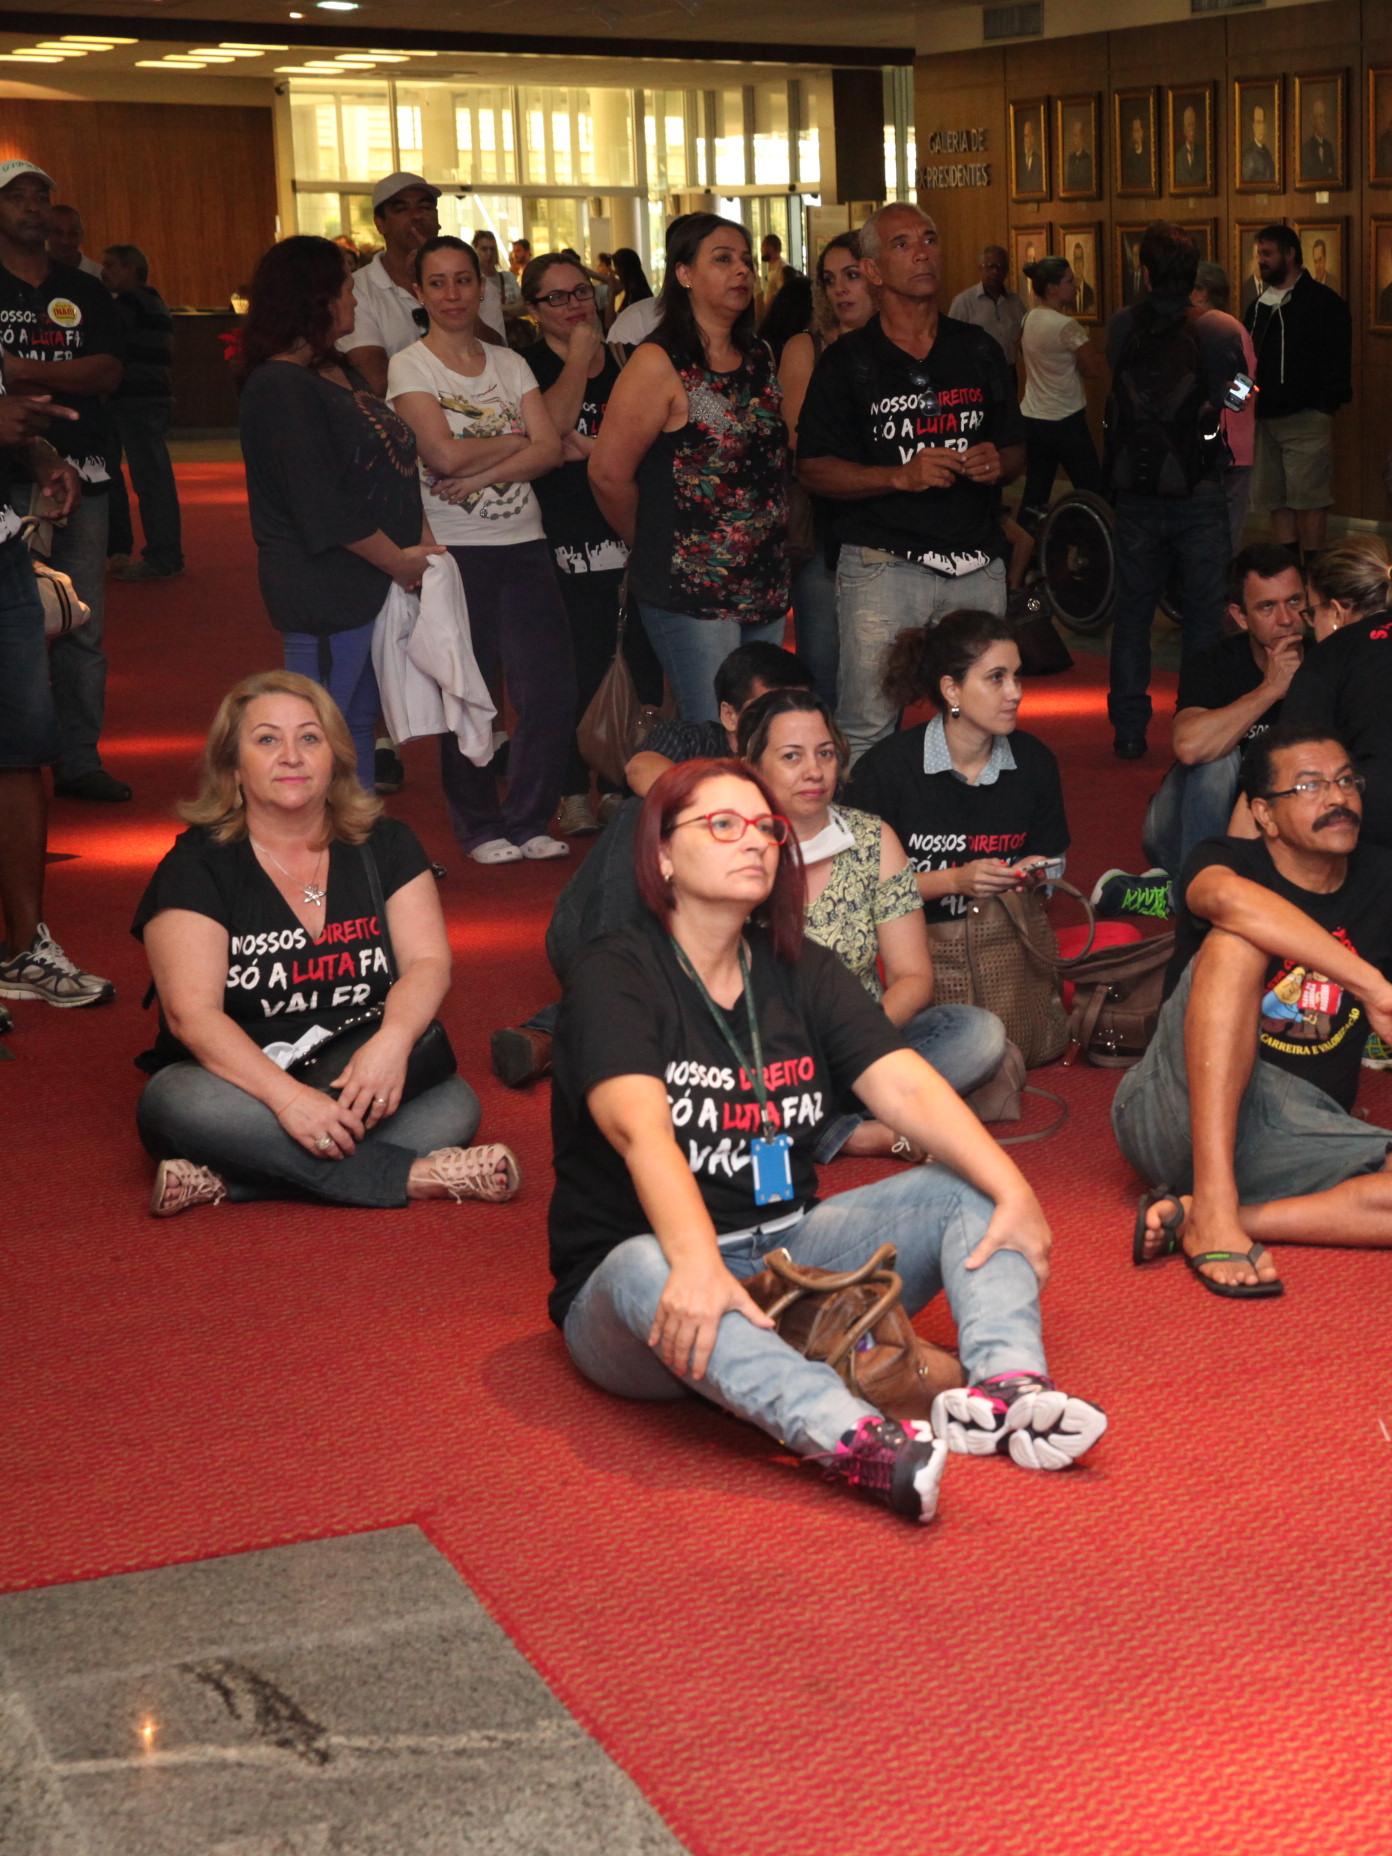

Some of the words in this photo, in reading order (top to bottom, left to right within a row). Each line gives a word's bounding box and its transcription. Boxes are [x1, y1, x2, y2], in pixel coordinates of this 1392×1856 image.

[929, 131, 969, 154] GALERIA
[971, 128, 985, 151] DE
[916, 163, 989, 188] X-PRESIDENTES
[0, 310, 37, 323] OSSOS
[19, 328, 28, 346] A
[870, 393, 926, 416] NOSSOS
[901, 418, 914, 439] A
[916, 413, 958, 436] LUTA
[908, 832, 967, 853] NOSSOS
[968, 831, 1028, 854] DIREITOS
[231, 927, 307, 956] NOSSOS
[226, 957, 260, 990] SÓ
[268, 962, 287, 991] A
[291, 951, 356, 985] LUTA
[358, 946, 389, 977] FA
[1260, 1033, 1311, 1055] CARREIRA
[1311, 1045, 1319, 1055] E
[1318, 1007, 1360, 1053] VALORIZAÇÃO
[697, 1097, 718, 1133] A
[722, 1100, 782, 1133] LUTA
[781, 1091, 824, 1129] FAZ
[689, 1137, 751, 1179] VAL
